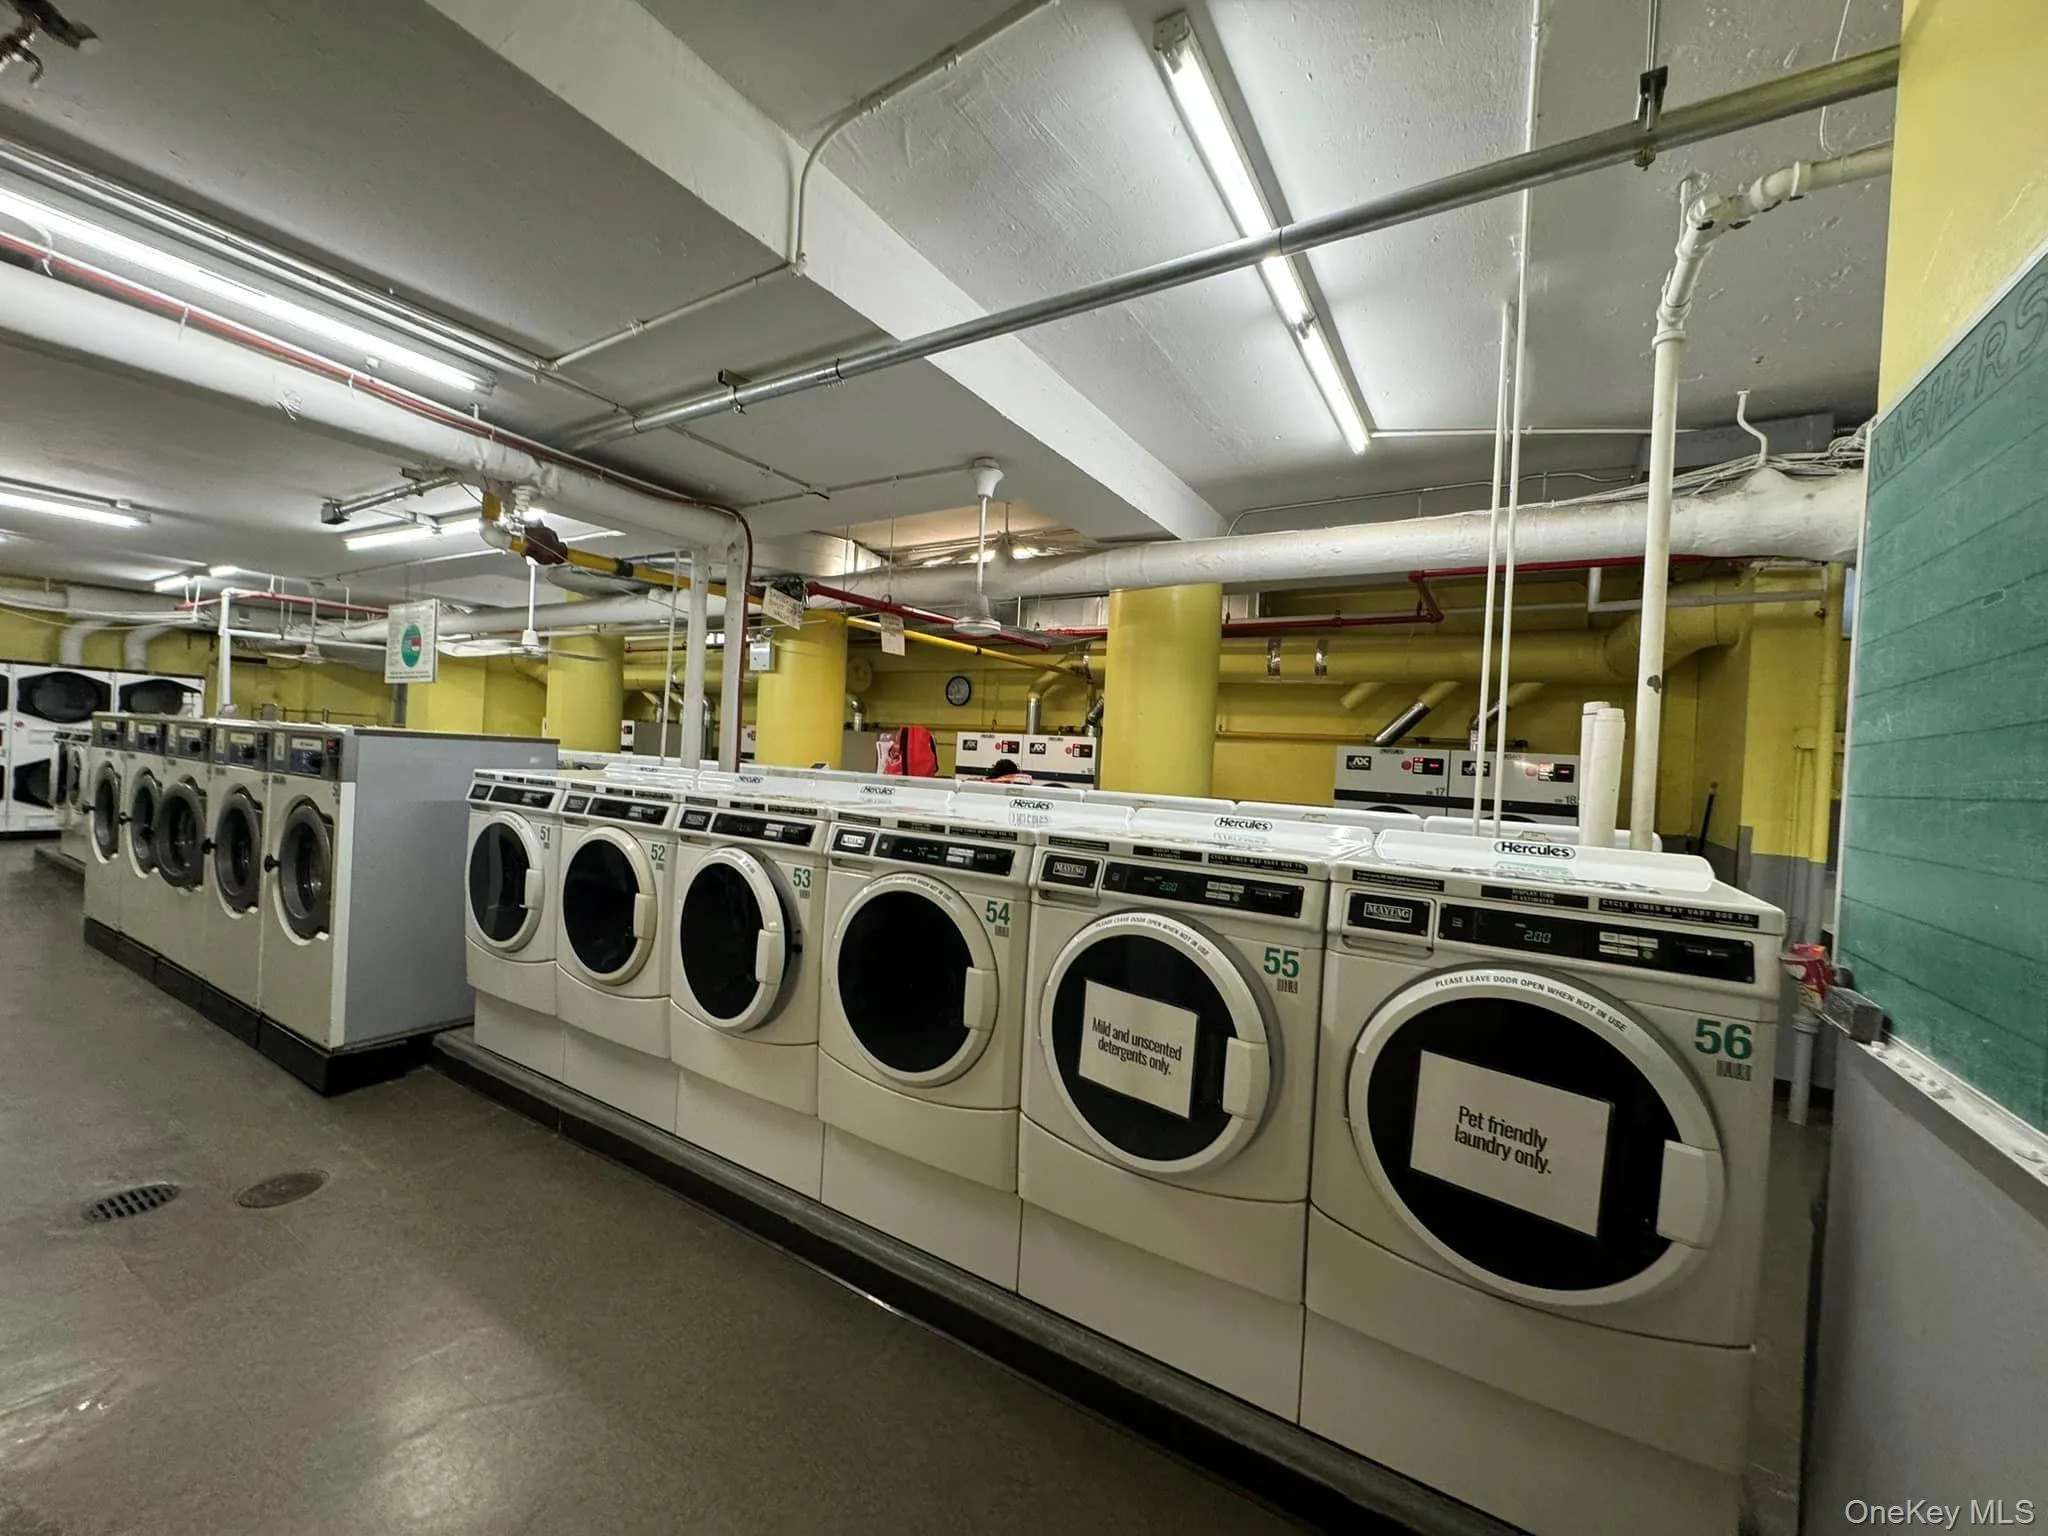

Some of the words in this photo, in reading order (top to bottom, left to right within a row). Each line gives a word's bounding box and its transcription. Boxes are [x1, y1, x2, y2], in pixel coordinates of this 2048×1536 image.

[1435, 788, 1445, 796] 17
[1013, 800, 1050, 810] Hercules
[540, 826, 550, 842] 51
[1219, 817, 1268, 831] Hercules
[651, 843, 665, 862] 52
[1501, 841, 1570, 857] Hercules
[793, 867, 811, 888] 53
[985, 900, 1011, 925] 54
[1367, 904, 1409, 919] MAYTAG
[1263, 947, 1300, 978] 55
[1435, 975, 1463, 988] PLEASE
[1465, 975, 1490, 983] LEAVE
[1493, 975, 1518, 984] DOOR
[1520, 979, 1545, 991] OPEN
[1547, 986, 1574, 1002] WHEN
[1576, 998, 1595, 1012] NOT
[1596, 1008, 1607, 1019] IN
[1607, 1015, 1627, 1032] USE
[1092, 1017, 1111, 1034] Mild
[1112, 1028, 1129, 1043] and
[1131, 1034, 1182, 1061] unscented
[1694, 1018, 1753, 1060] 56
[1098, 1036, 1147, 1065] detergents
[1149, 1057, 1172, 1075] only.
[1458, 1105, 1484, 1130] Pet
[1488, 1115, 1548, 1151] friendly
[1454, 1125, 1511, 1161] laundry
[1514, 1148, 1552, 1174] only.
